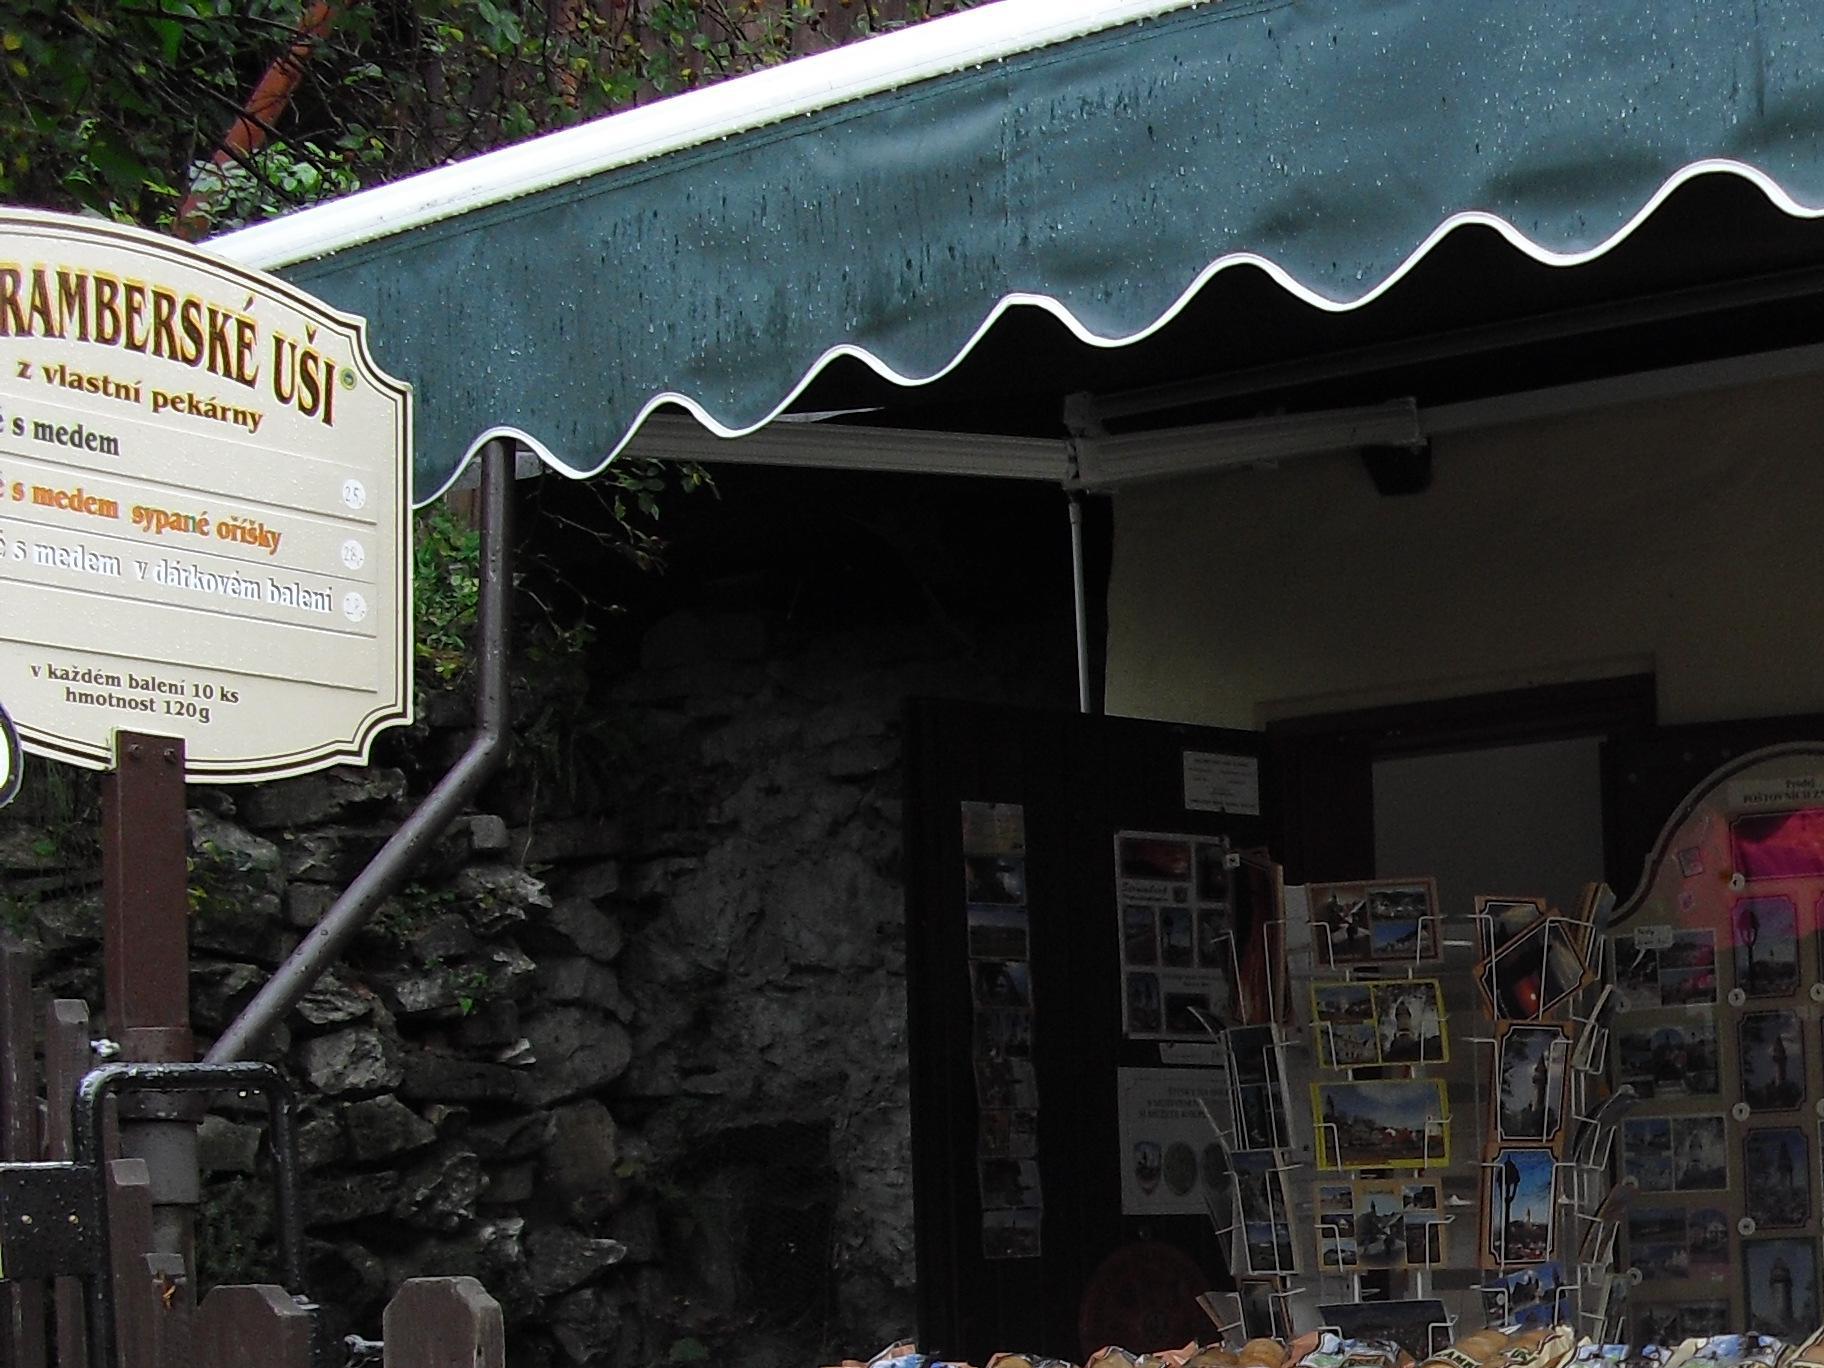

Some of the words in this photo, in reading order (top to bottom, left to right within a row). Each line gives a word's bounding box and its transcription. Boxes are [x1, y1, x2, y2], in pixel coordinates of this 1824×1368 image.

[16, 360, 32, 380] z
[42, 363, 143, 404] vlastní
[152, 390, 264, 434] pekárny
[271, 322, 336, 427] UŠI
[13, 416, 25, 436] s
[33, 421, 120, 456] medem
[12, 482, 25, 502] s
[32, 486, 119, 519] medem
[131, 504, 211, 536] sypané
[216, 515, 282, 556] oříšky
[12, 540, 27, 561] s
[33, 543, 121, 577] medem
[134, 559, 148, 580] v
[154, 559, 261, 600] dárkovém
[30, 663, 41, 678] v
[48, 663, 122, 688] každém
[129, 673, 186, 696] balení
[192, 684, 214, 700] 10
[220, 687, 239, 704] ks
[65, 687, 156, 713] hmotnost
